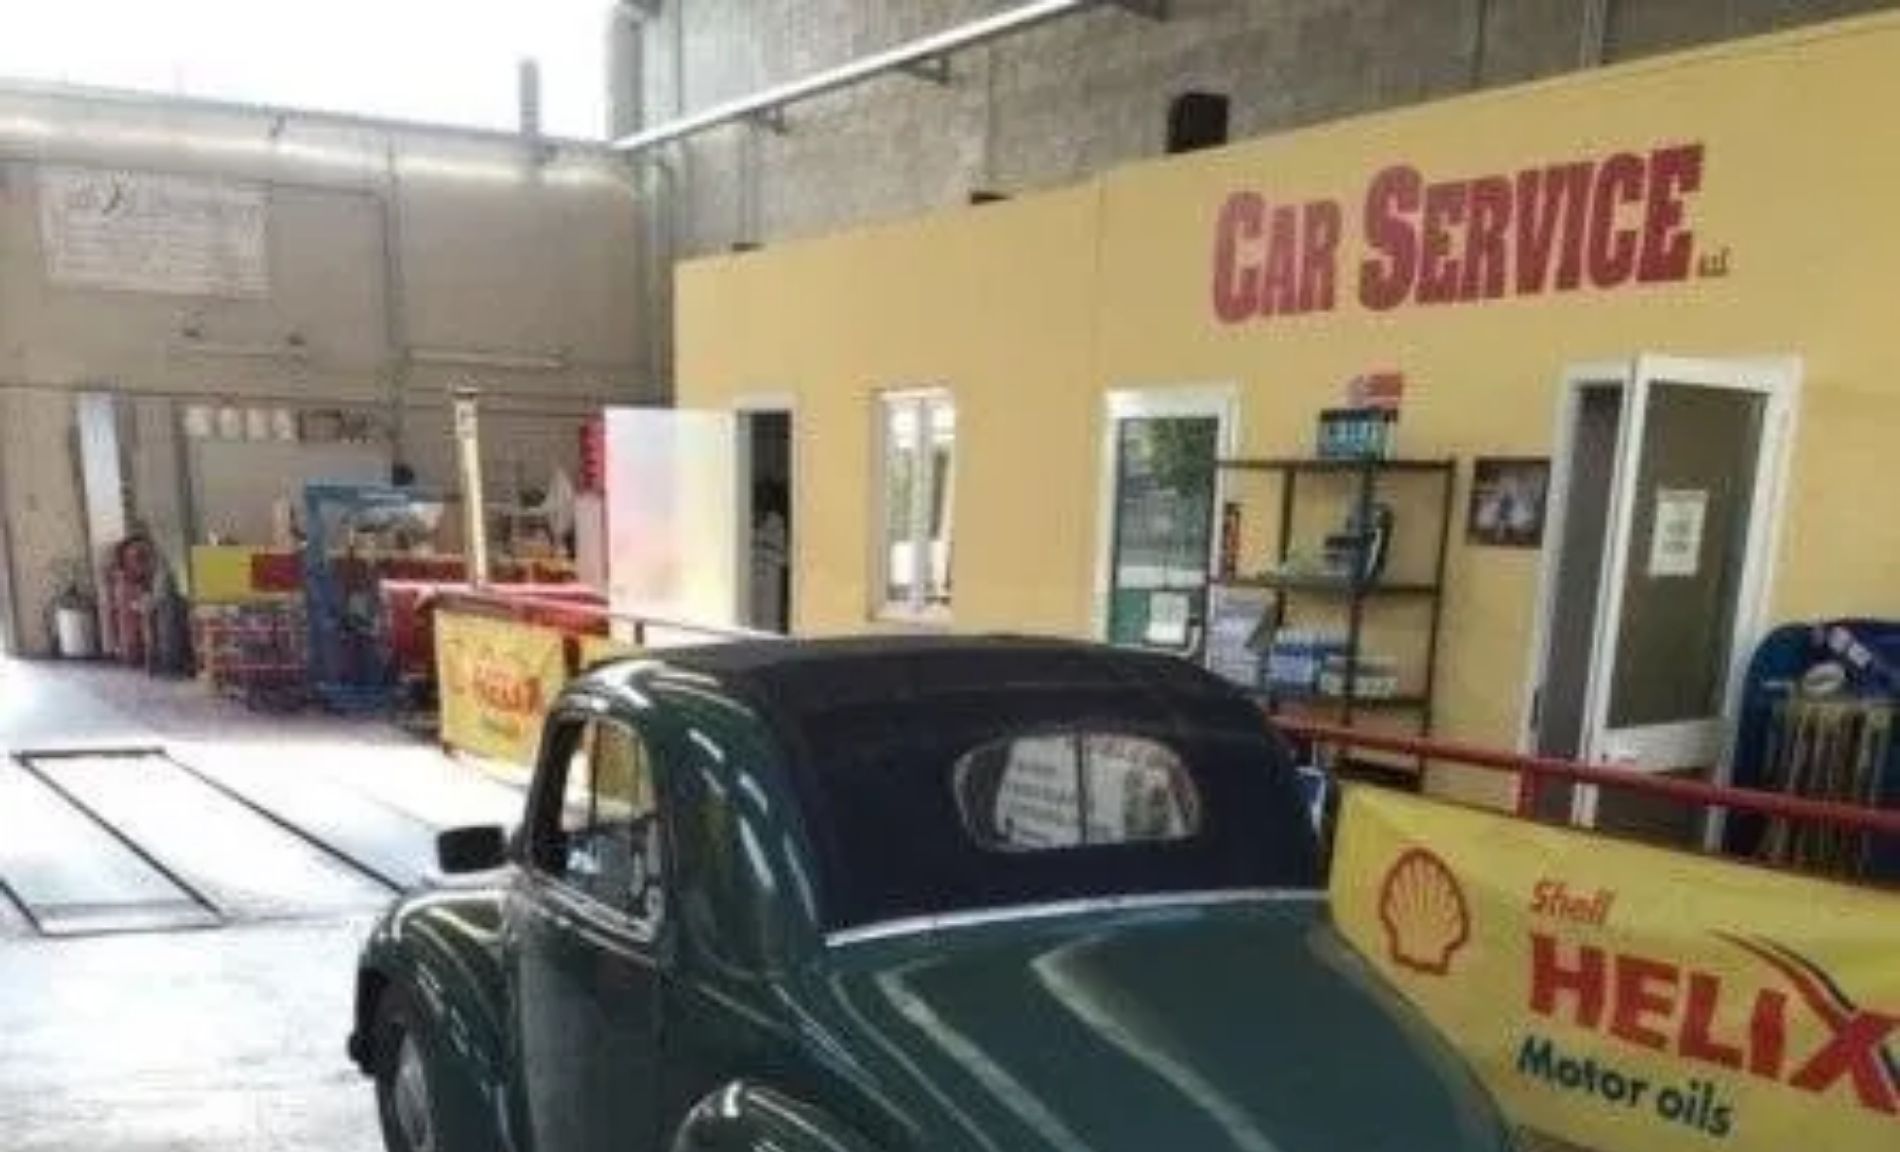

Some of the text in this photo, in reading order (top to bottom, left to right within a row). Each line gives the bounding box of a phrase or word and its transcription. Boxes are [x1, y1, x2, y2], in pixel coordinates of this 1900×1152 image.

[1213, 143, 1705, 324] CAR SERVICE
[1530, 880, 1617, 924] Shell
[1516, 1035, 1732, 1138] Motor oils
[1528, 930, 1900, 1117] HELIX
